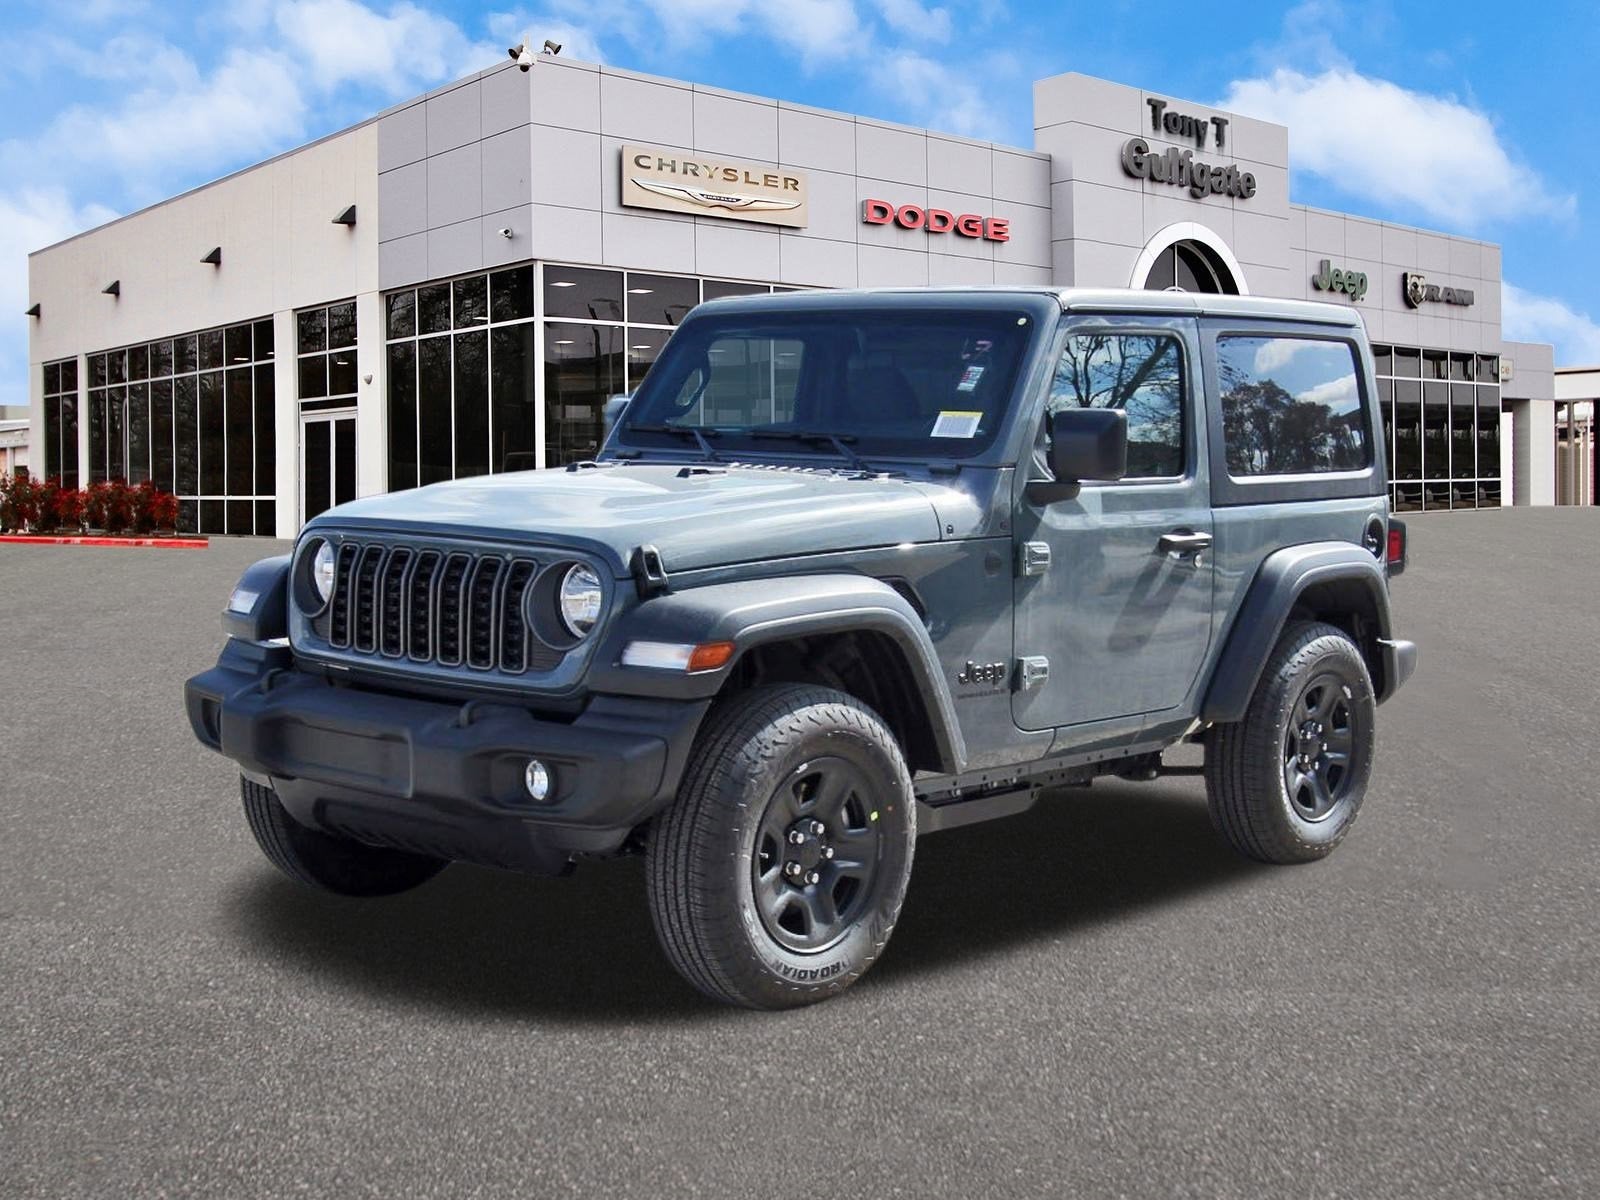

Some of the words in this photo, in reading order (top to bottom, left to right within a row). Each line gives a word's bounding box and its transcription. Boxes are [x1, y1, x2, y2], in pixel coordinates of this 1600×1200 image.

[1146, 98, 1208, 147] Tony
[1210, 116, 1229, 147] T
[633, 154, 801, 192] CHRYSLER
[1121, 138, 1257, 199] Gulfgate
[861, 198, 1010, 243] DODGE
[1311, 259, 1368, 302] Jeep
[1424, 284, 1475, 307] RAM
[957, 660, 1006, 690] Jeep
